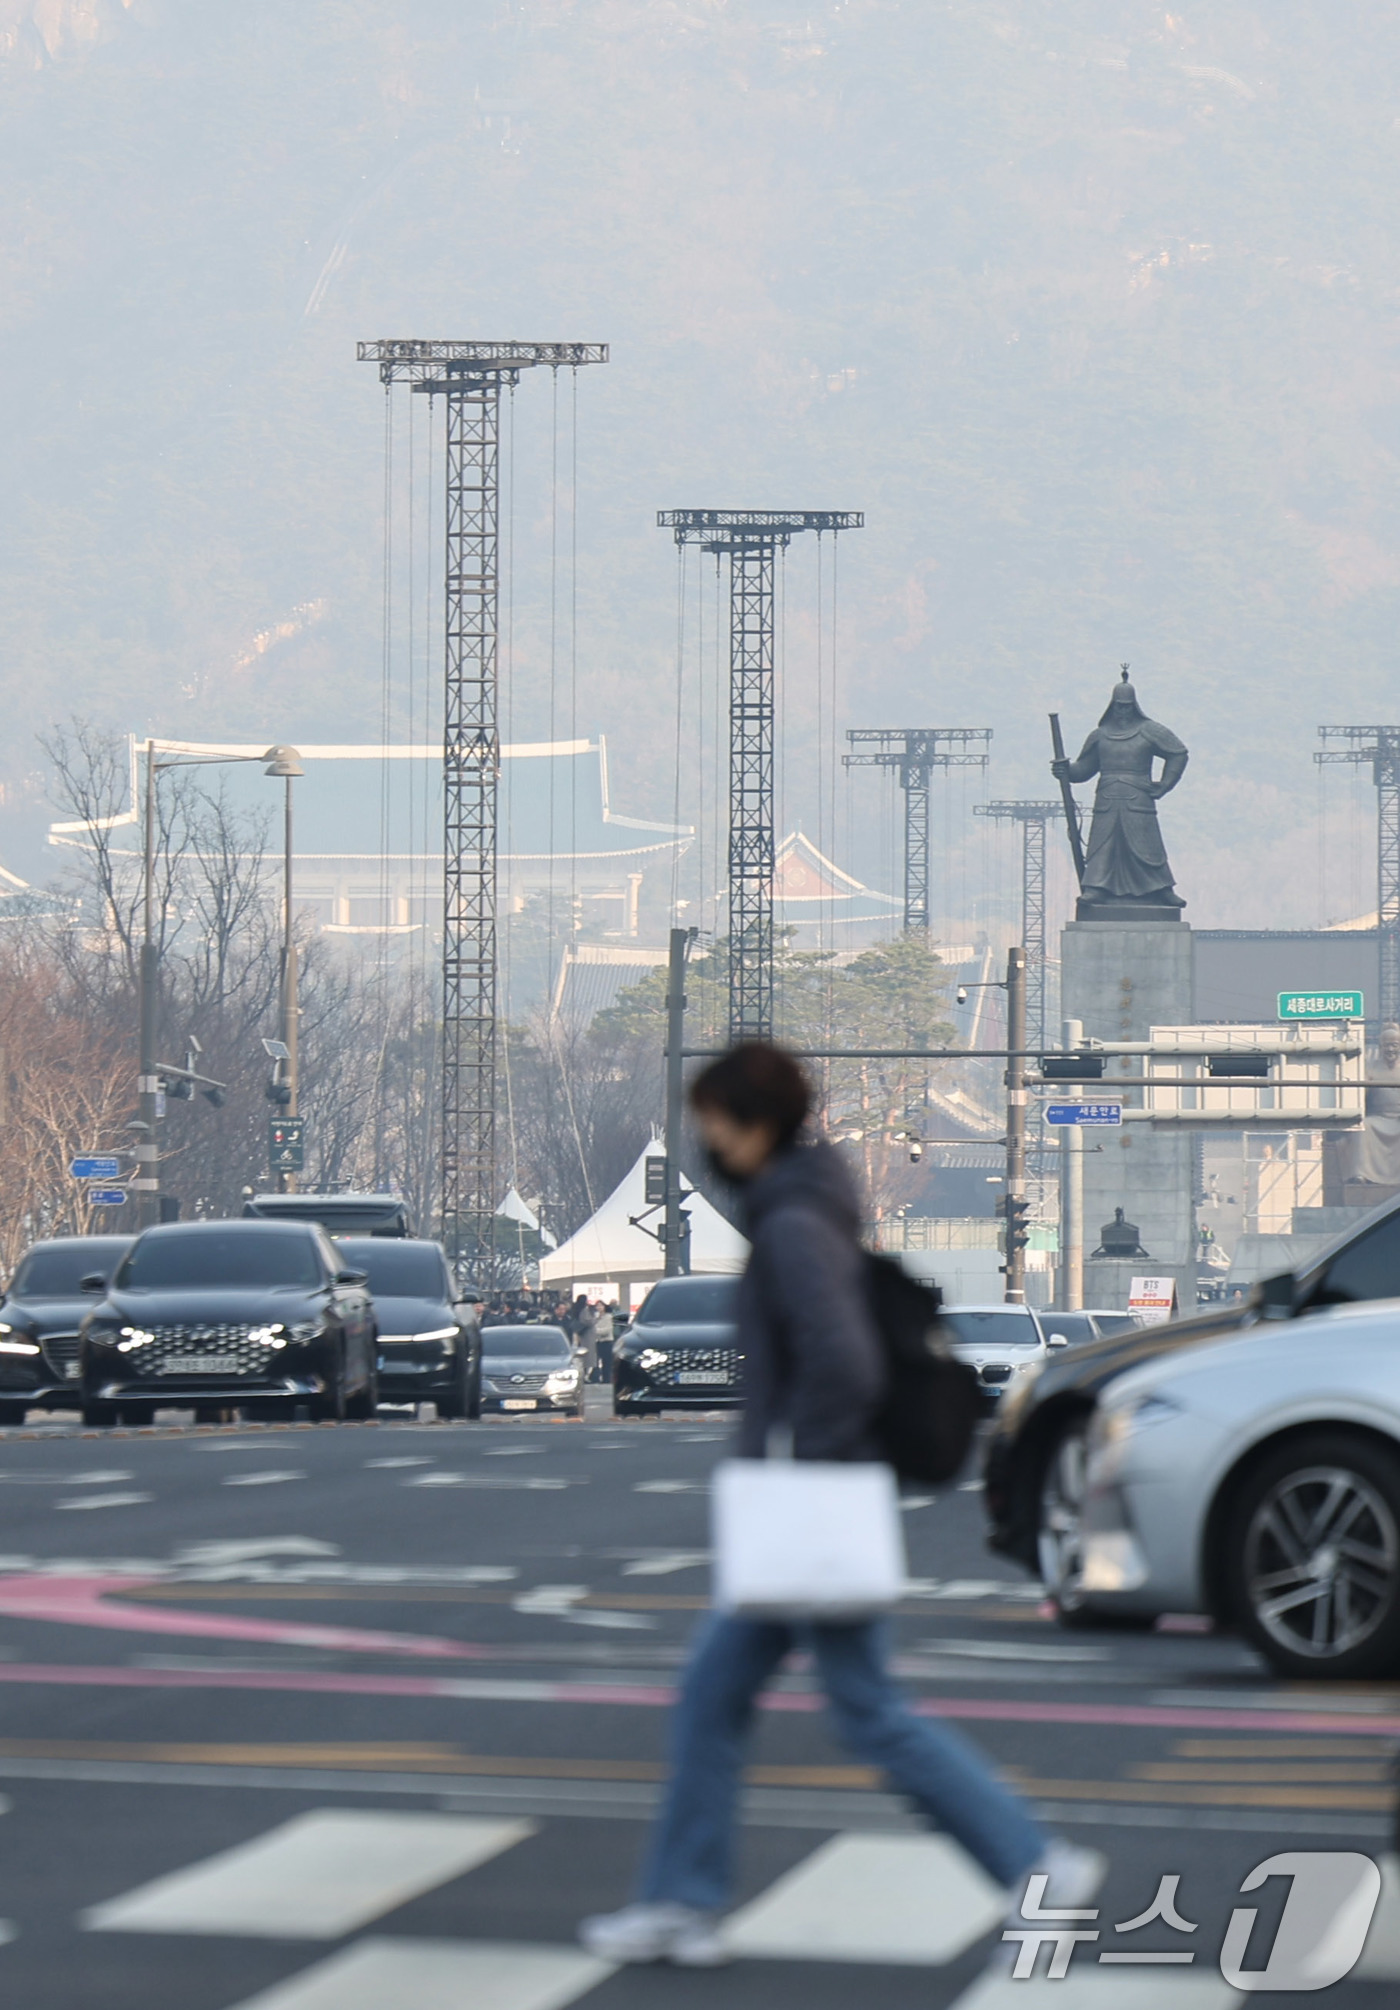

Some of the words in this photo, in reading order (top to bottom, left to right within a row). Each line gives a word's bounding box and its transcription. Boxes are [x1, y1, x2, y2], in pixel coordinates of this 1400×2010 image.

[1286, 996, 1354, 1013] 세종대로사거리
[1079, 1106, 1119, 1117] 새문안로
[1143, 1280, 1160, 1290] BTS
[587, 1286, 604, 1296] BTS
